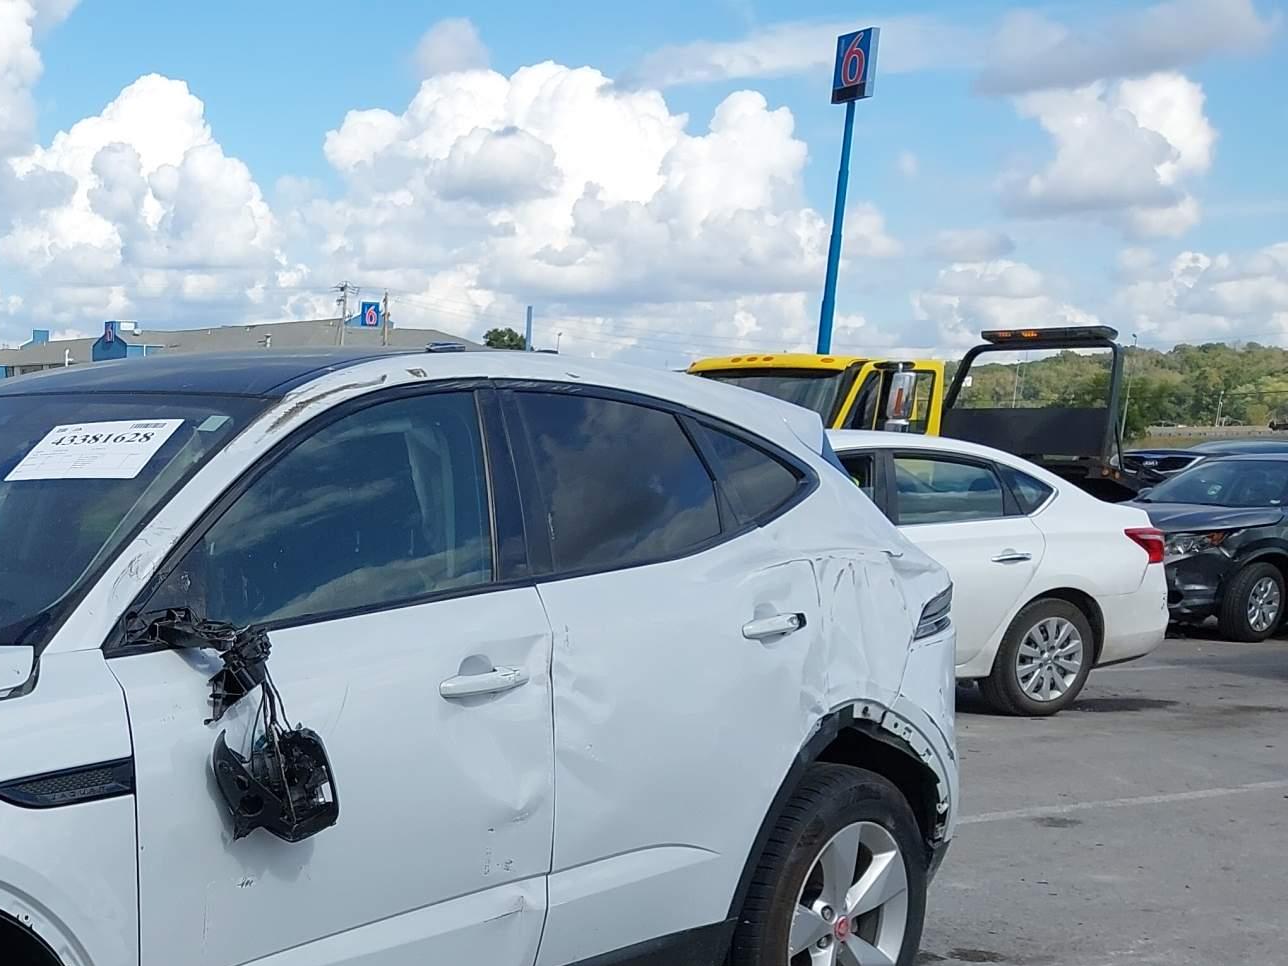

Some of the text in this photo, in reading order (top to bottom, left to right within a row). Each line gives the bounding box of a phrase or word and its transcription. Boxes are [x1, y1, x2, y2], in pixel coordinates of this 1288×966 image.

[842, 32, 865, 87] 6
[365, 305, 377, 326] 6
[51, 432, 155, 446] 43381628
